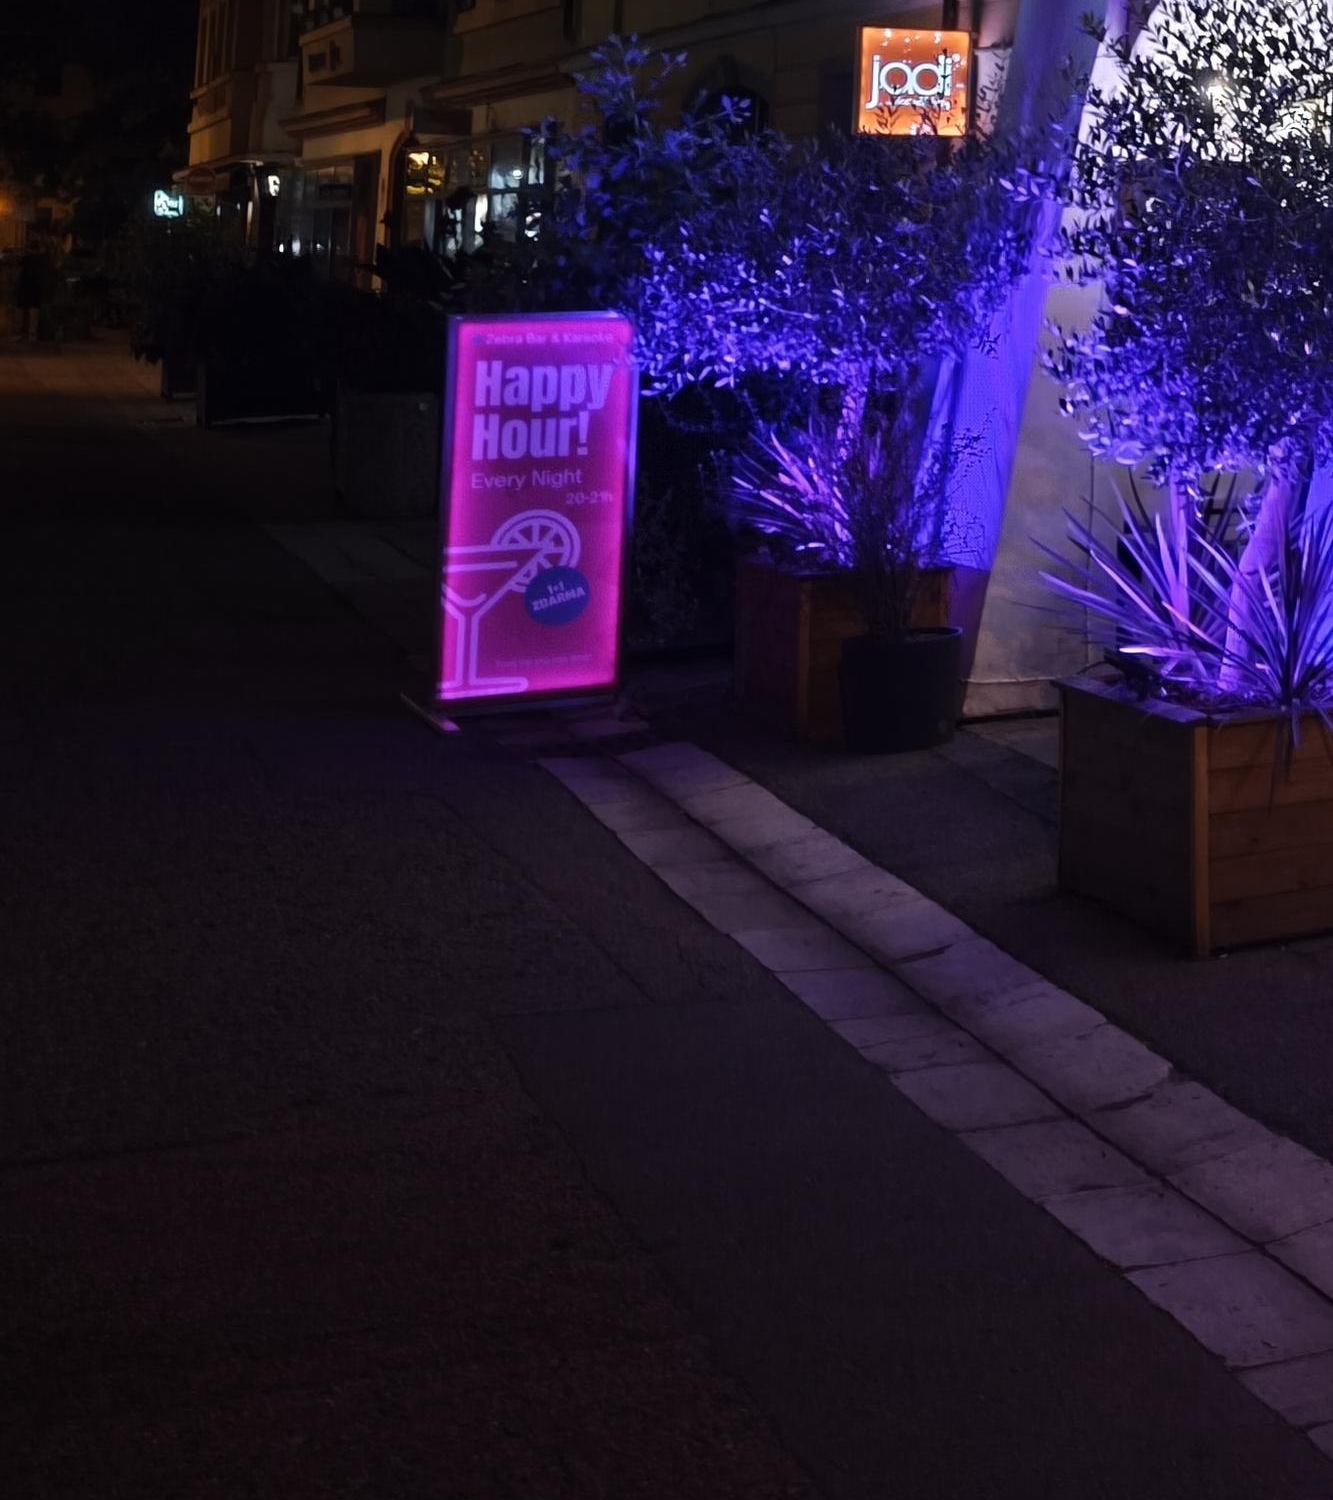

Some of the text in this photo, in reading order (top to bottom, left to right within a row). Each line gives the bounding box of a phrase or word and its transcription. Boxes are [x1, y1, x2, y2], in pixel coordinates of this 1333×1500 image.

[475, 360, 614, 413] Happy
[472, 411, 589, 461] Hour!
[471, 468, 584, 491] Every Night
[532, 587, 586, 611] ZDARMA
[547, 581, 565, 595] 1+1
